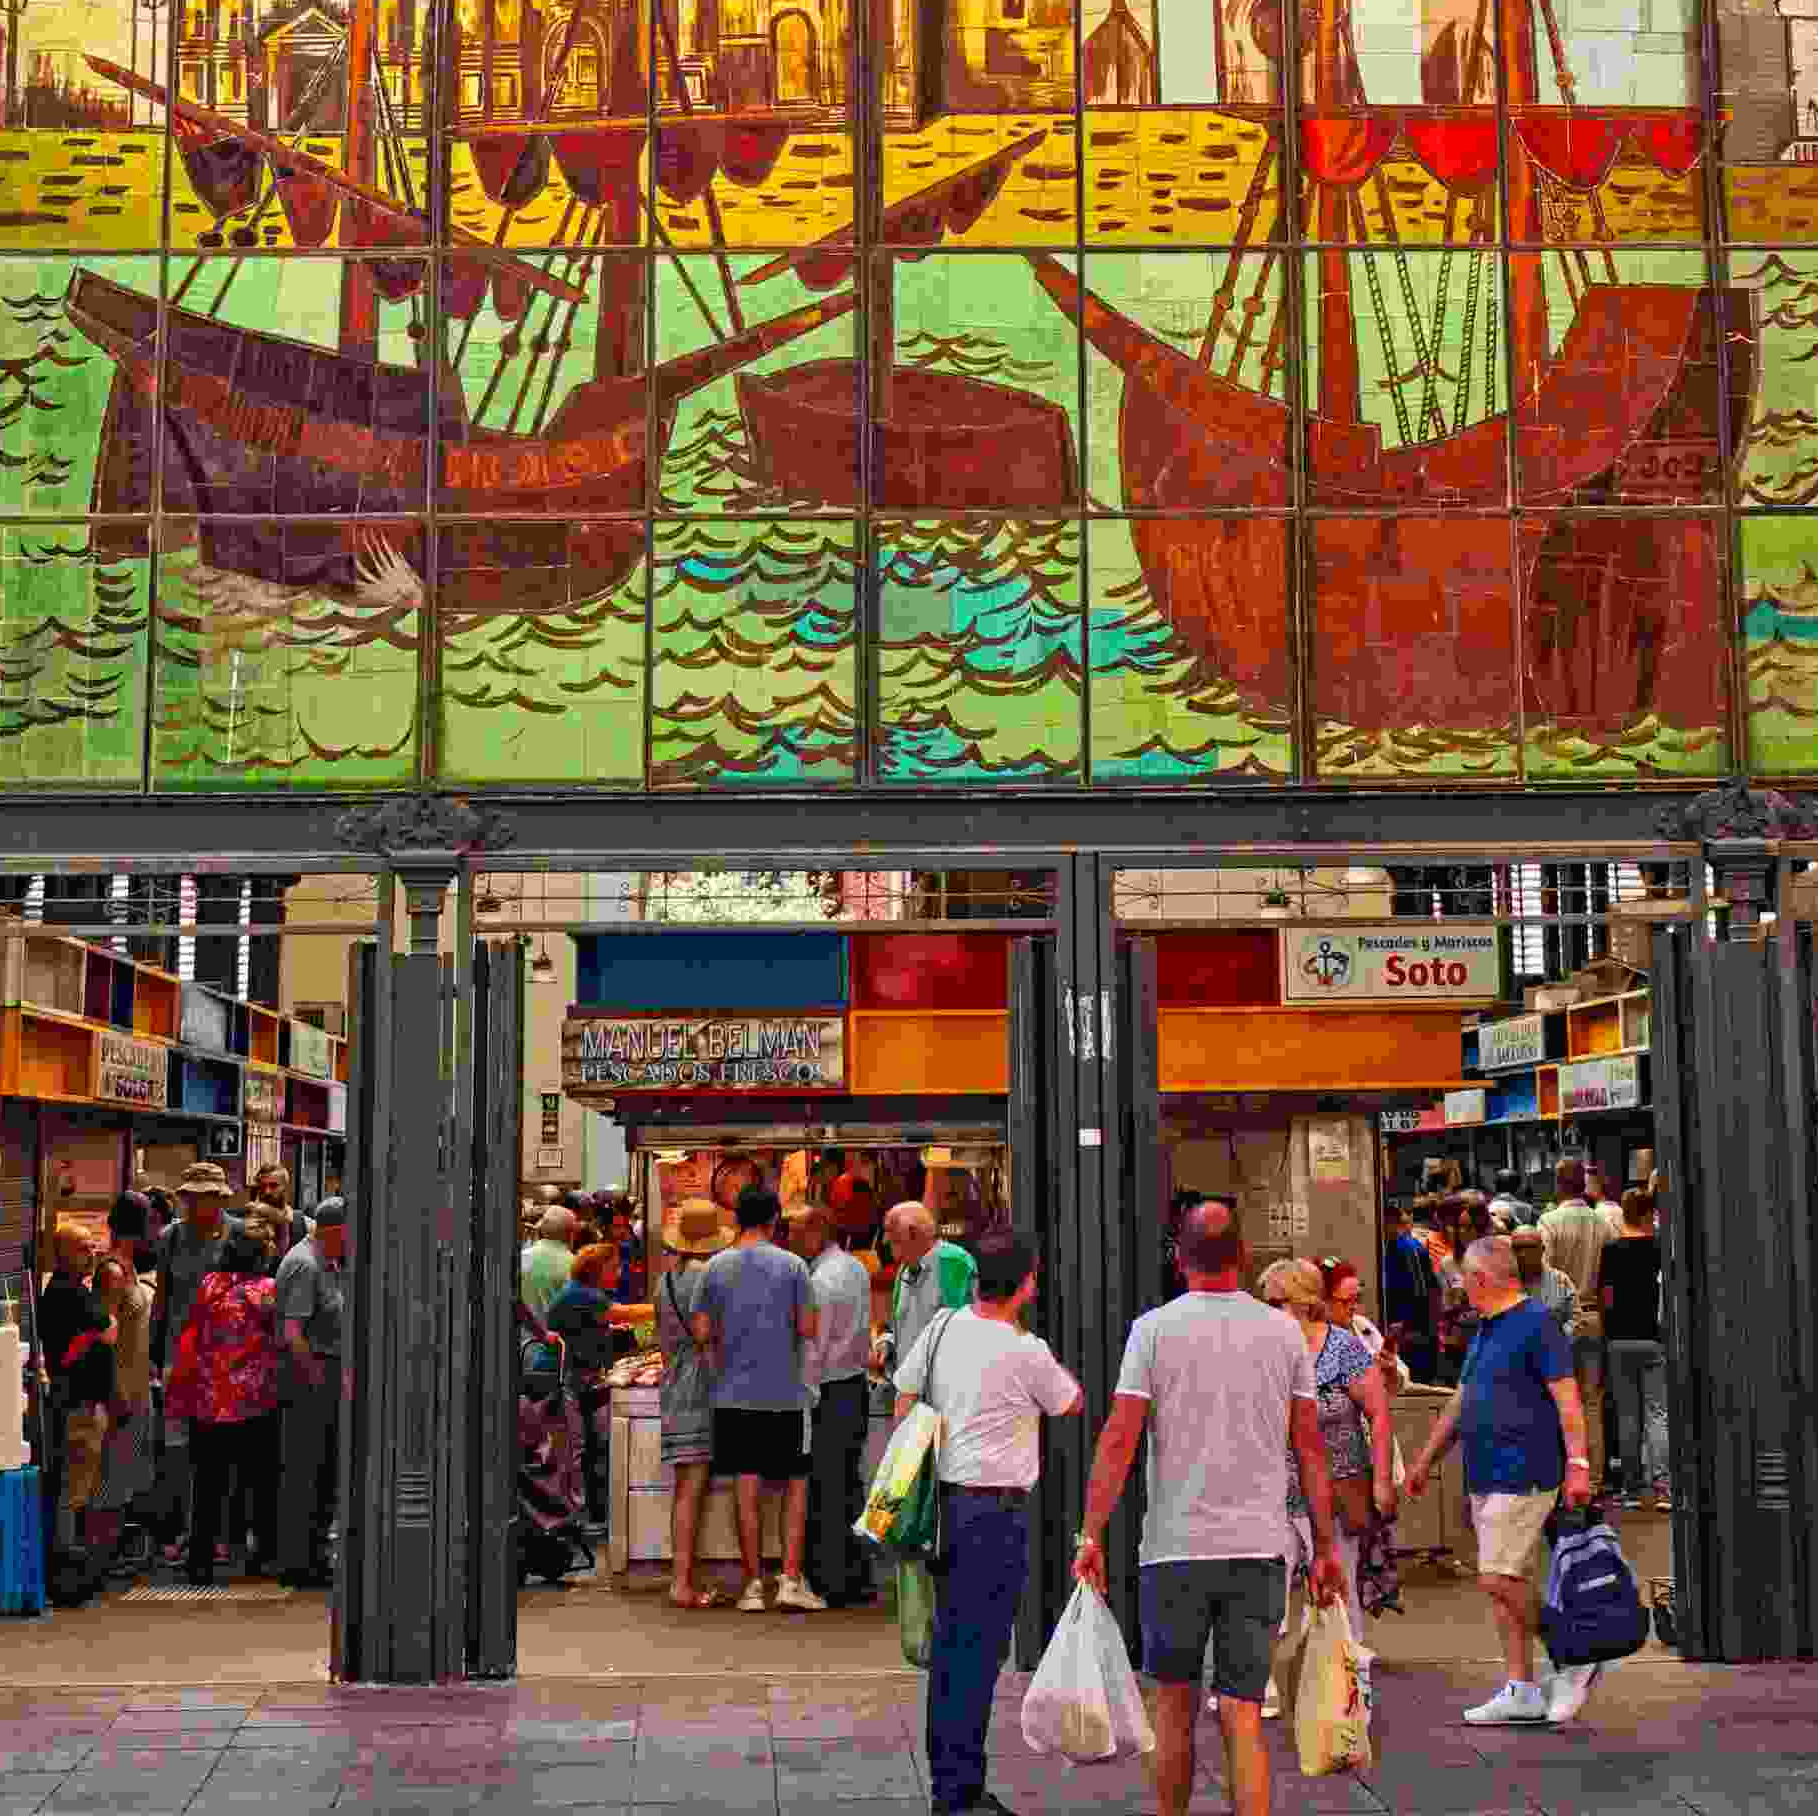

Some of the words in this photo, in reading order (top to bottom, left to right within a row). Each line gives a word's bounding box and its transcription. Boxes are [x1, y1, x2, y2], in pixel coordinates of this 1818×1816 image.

[1421, 939, 1430, 952] y
[1433, 935, 1493, 950] Mariscos
[1385, 952, 1467, 986] Soto
[581, 1024, 696, 1059] MANUEL
[581, 1063, 710, 1081] PESCADOS
[720, 1063, 822, 1081] FRESCOS
